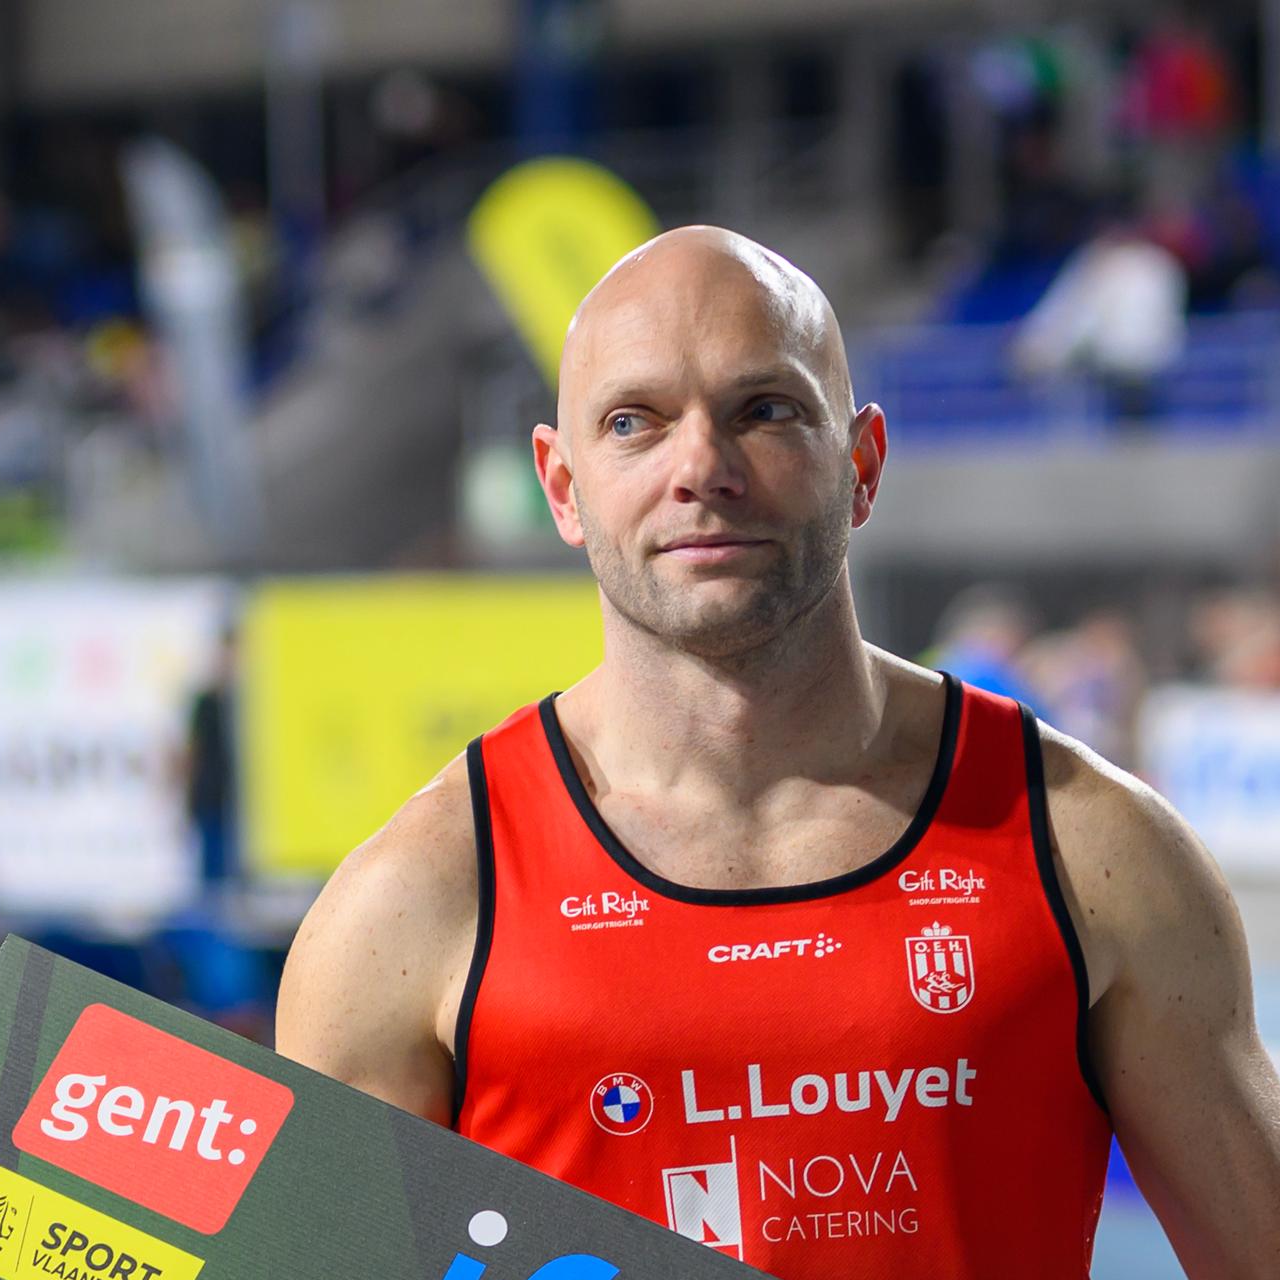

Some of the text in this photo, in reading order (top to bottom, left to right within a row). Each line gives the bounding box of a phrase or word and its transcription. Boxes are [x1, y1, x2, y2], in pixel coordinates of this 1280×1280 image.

[898, 868, 986, 896] Gift Right
[560, 890, 650, 918] Gift Right
[708, 938, 812, 964] CRAFT
[680, 1058, 978, 1124] L.Louyet
[40, 1073, 257, 1165] gent:
[759, 1150, 919, 1201] NOVA
[761, 1206, 920, 1244] CATERING
